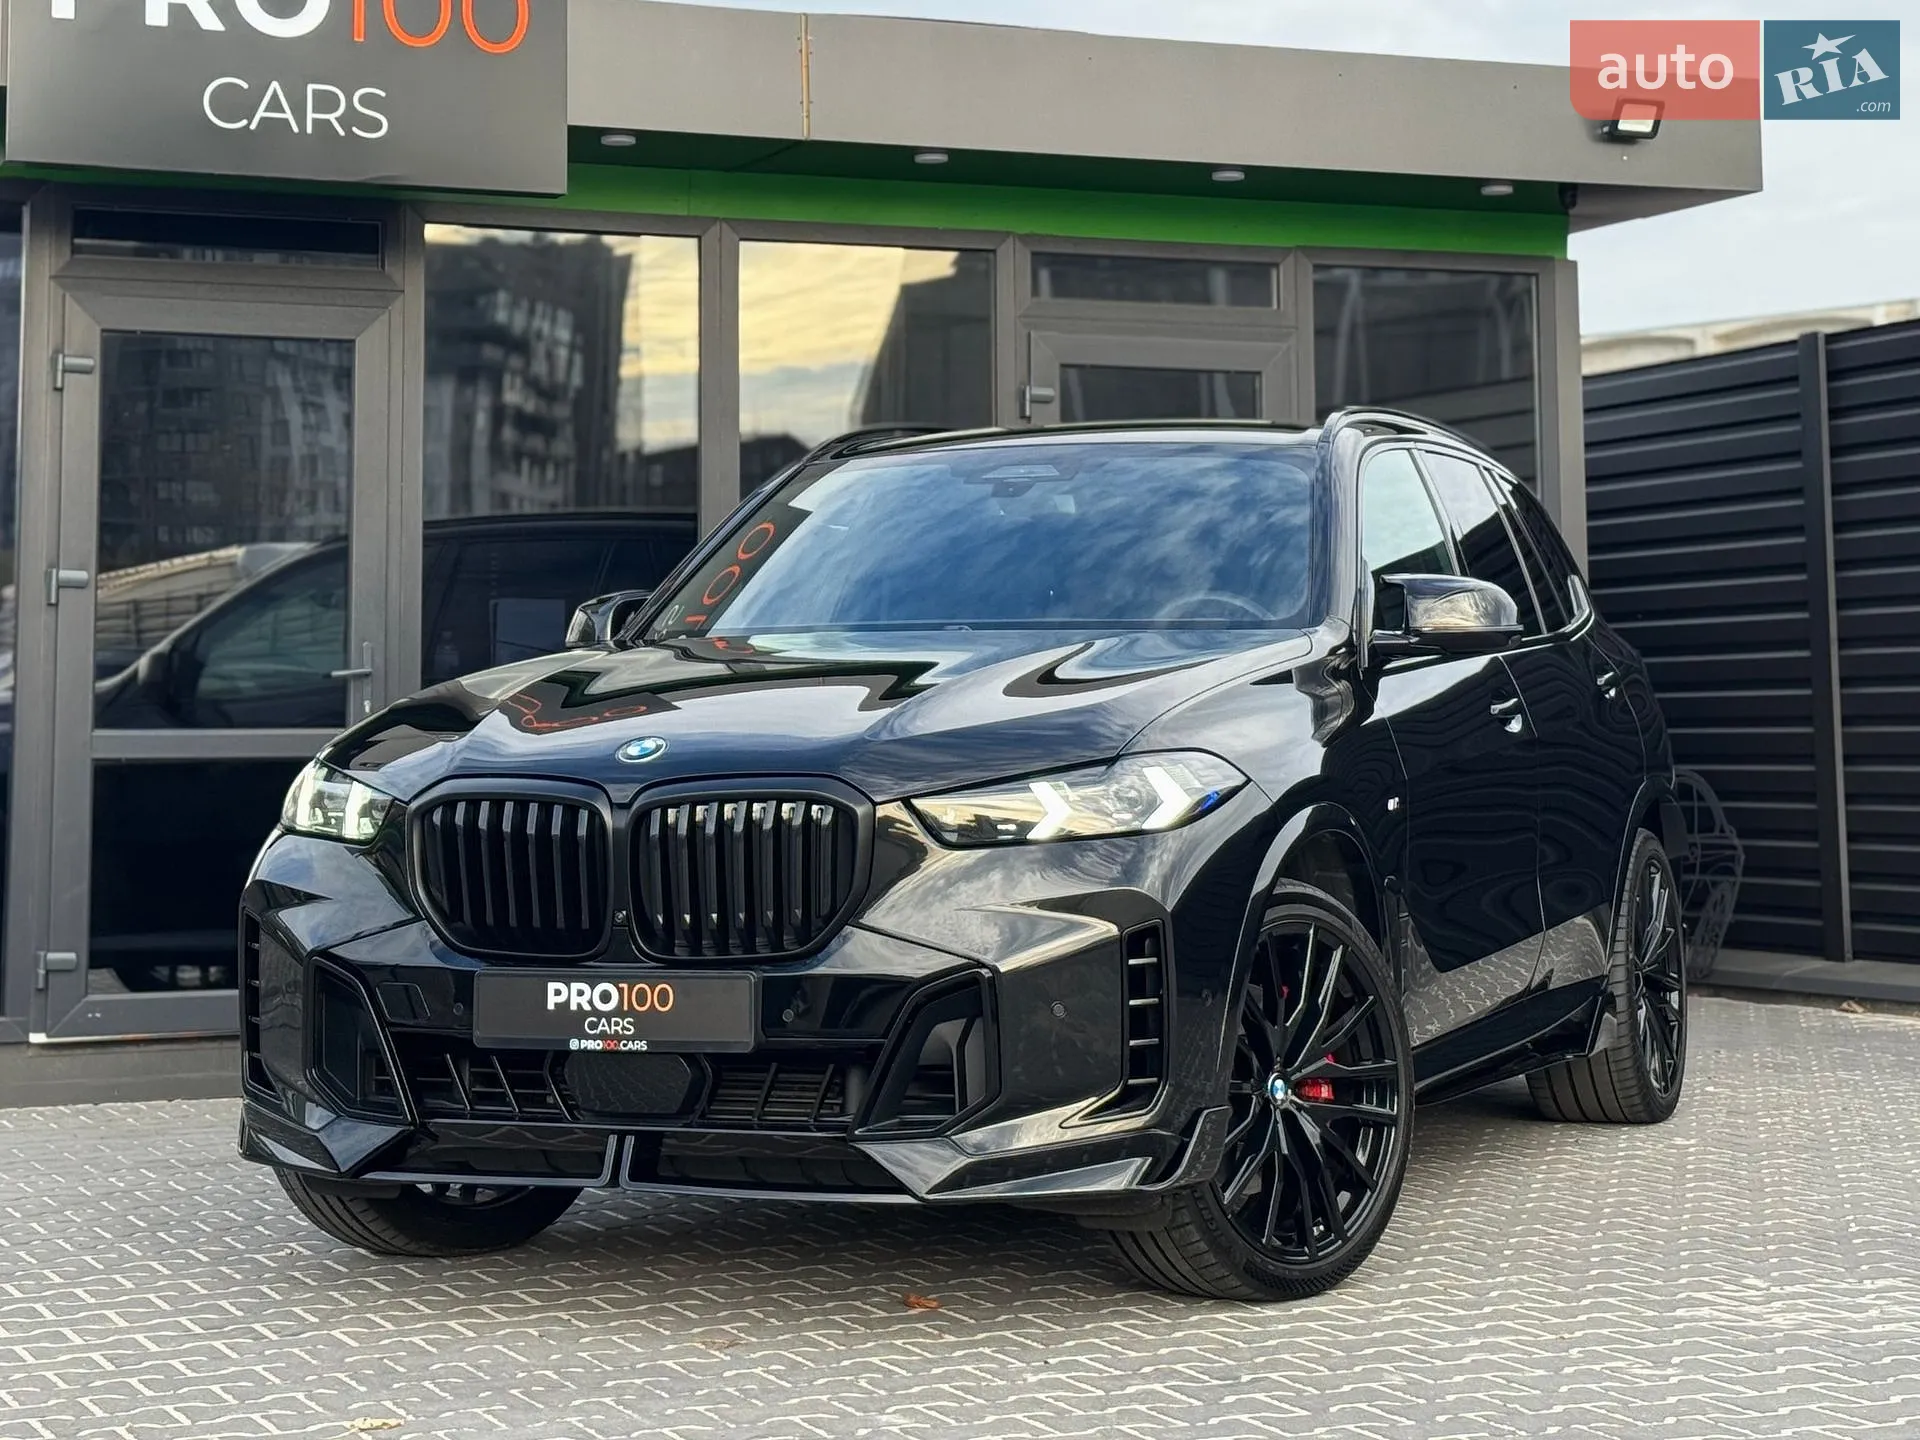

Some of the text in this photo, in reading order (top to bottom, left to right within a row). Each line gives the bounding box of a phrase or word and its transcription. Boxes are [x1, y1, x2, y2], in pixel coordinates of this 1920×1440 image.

[202, 76, 389, 139] CARS
[547, 981, 674, 1012] PRO100
[584, 1017, 635, 1035] CARS
